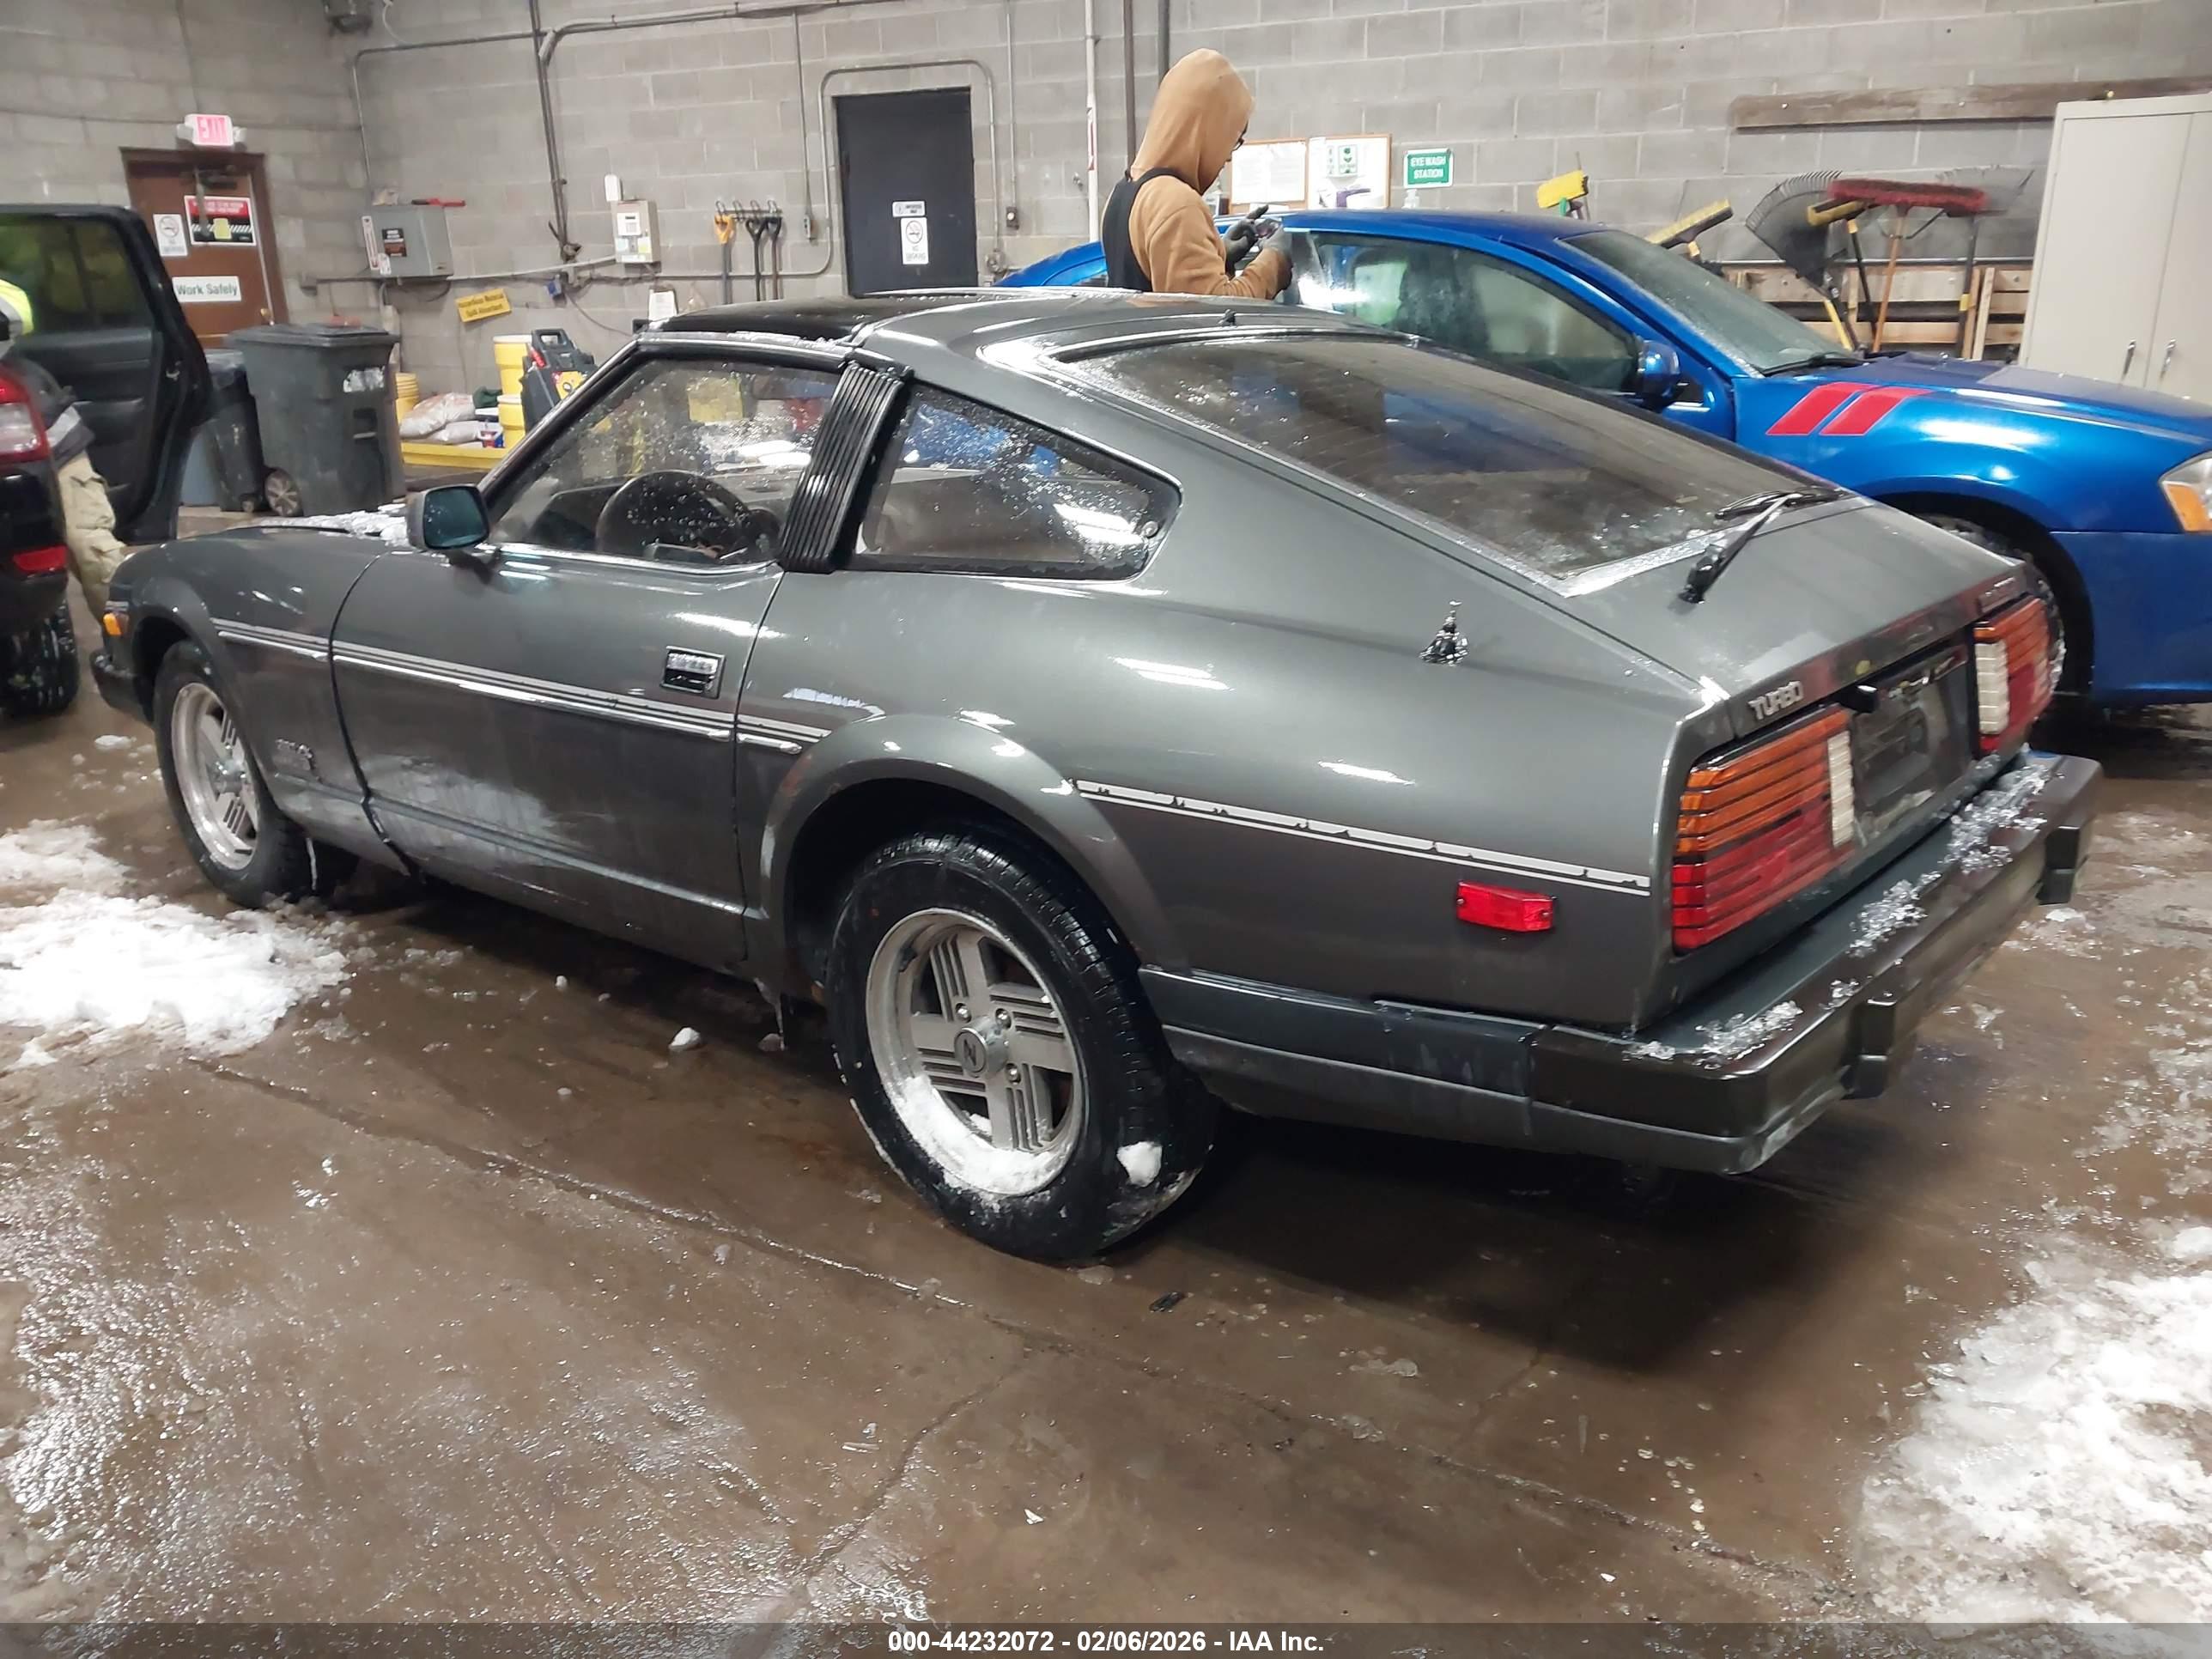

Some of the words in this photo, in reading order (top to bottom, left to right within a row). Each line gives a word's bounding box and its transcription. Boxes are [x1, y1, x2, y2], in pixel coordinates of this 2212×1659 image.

[197, 117, 228, 143] EXIT
[1410, 157, 1425, 167] EYE
[1413, 168, 1444, 179] STATION
[177, 283, 204, 295] Work
[205, 283, 238, 296] Safely
[1747, 680, 1803, 720] TURBO
